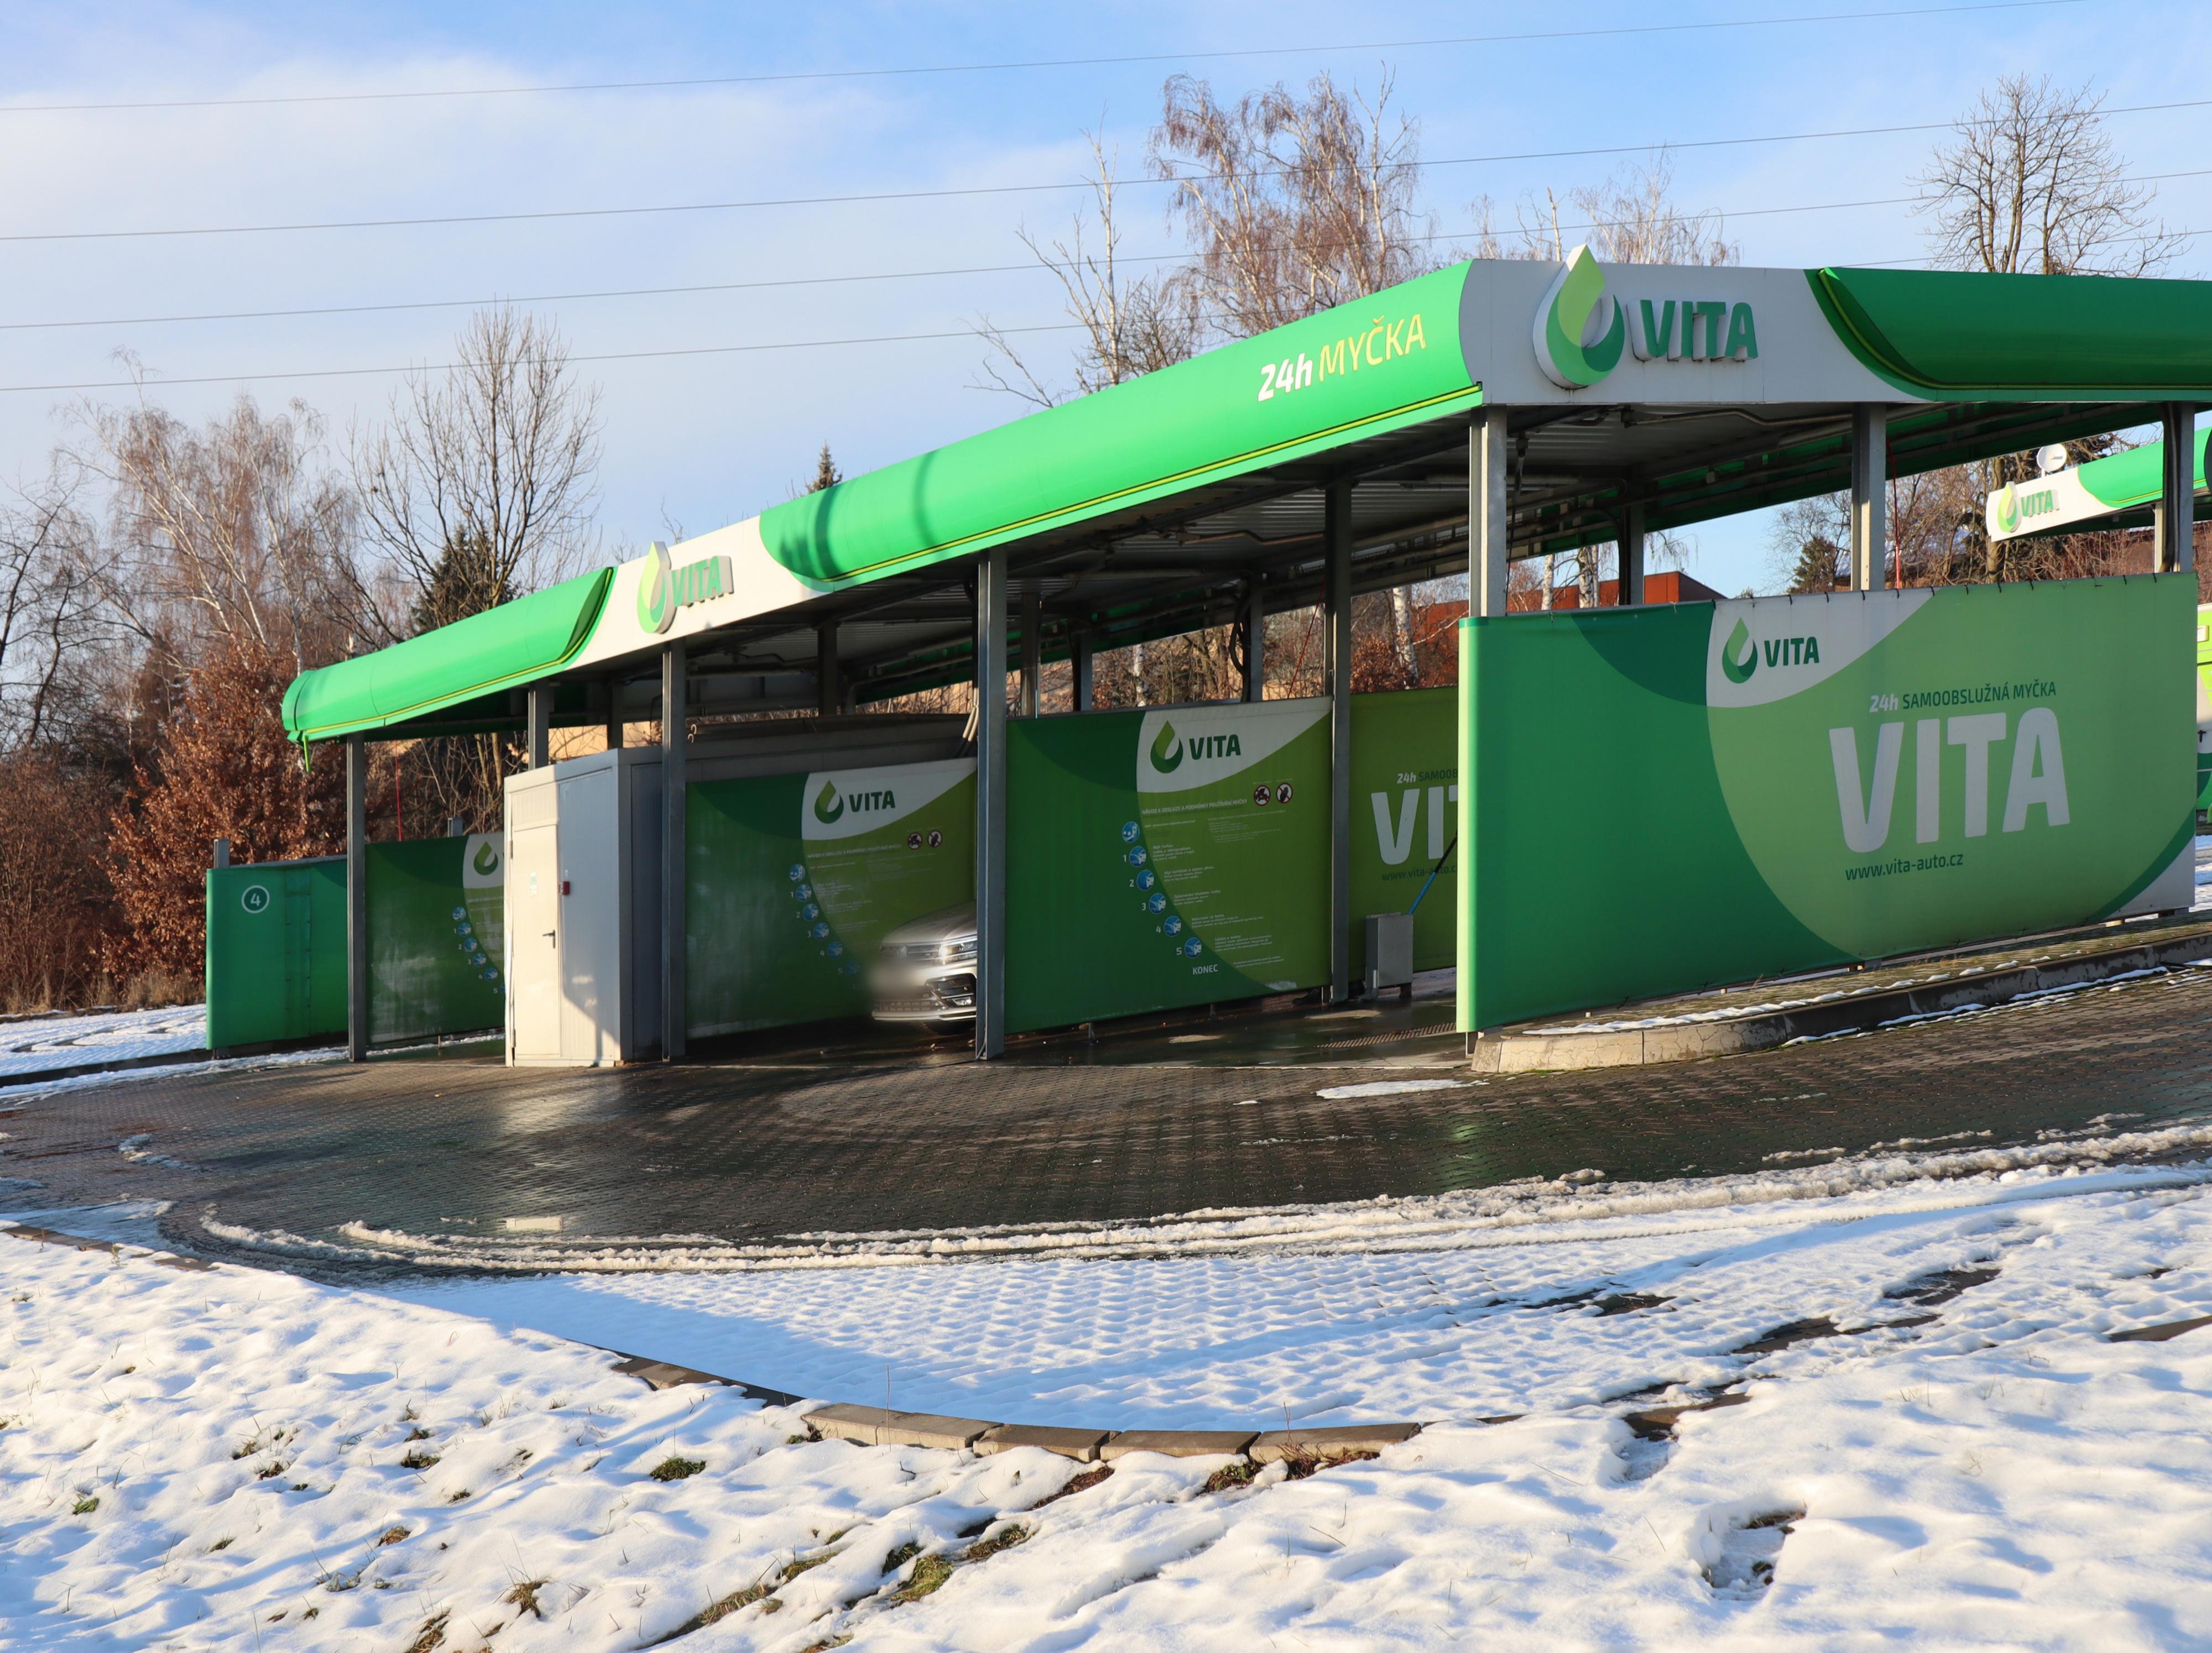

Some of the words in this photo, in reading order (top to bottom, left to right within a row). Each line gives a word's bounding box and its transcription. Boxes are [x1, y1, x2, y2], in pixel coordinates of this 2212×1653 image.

[1639, 299, 1759, 359] VITA
[1258, 352, 1313, 402] 24h
[1319, 313, 1427, 381] MYČKA
[2021, 489, 2054, 517] VITA
[671, 556, 722, 607] VITA
[1764, 636, 1819, 668] VITA
[1869, 694, 1898, 713] 24h
[1902, 682, 2010, 710] SAMOOBSLUŽNÁ
[2013, 678, 2057, 700] MYČKA
[1189, 734, 1241, 760] VITA
[1397, 772, 1416, 784] 24h
[1418, 769, 1458, 781] SAMOOB
[1829, 707, 2070, 853] VITA
[849, 790, 895, 812] VITA
[1371, 784, 1458, 865] VI
[1123, 854, 1126, 862] 1
[1845, 854, 1964, 881] www.vita-auto.cz
[1129, 879, 1134, 887] 2
[251, 893, 260, 906] 4
[1141, 902, 1146, 911] 3
[1156, 925, 1161, 934] 4
[1176, 947, 1182, 955] 5
[1192, 964, 1218, 975] KONEC
